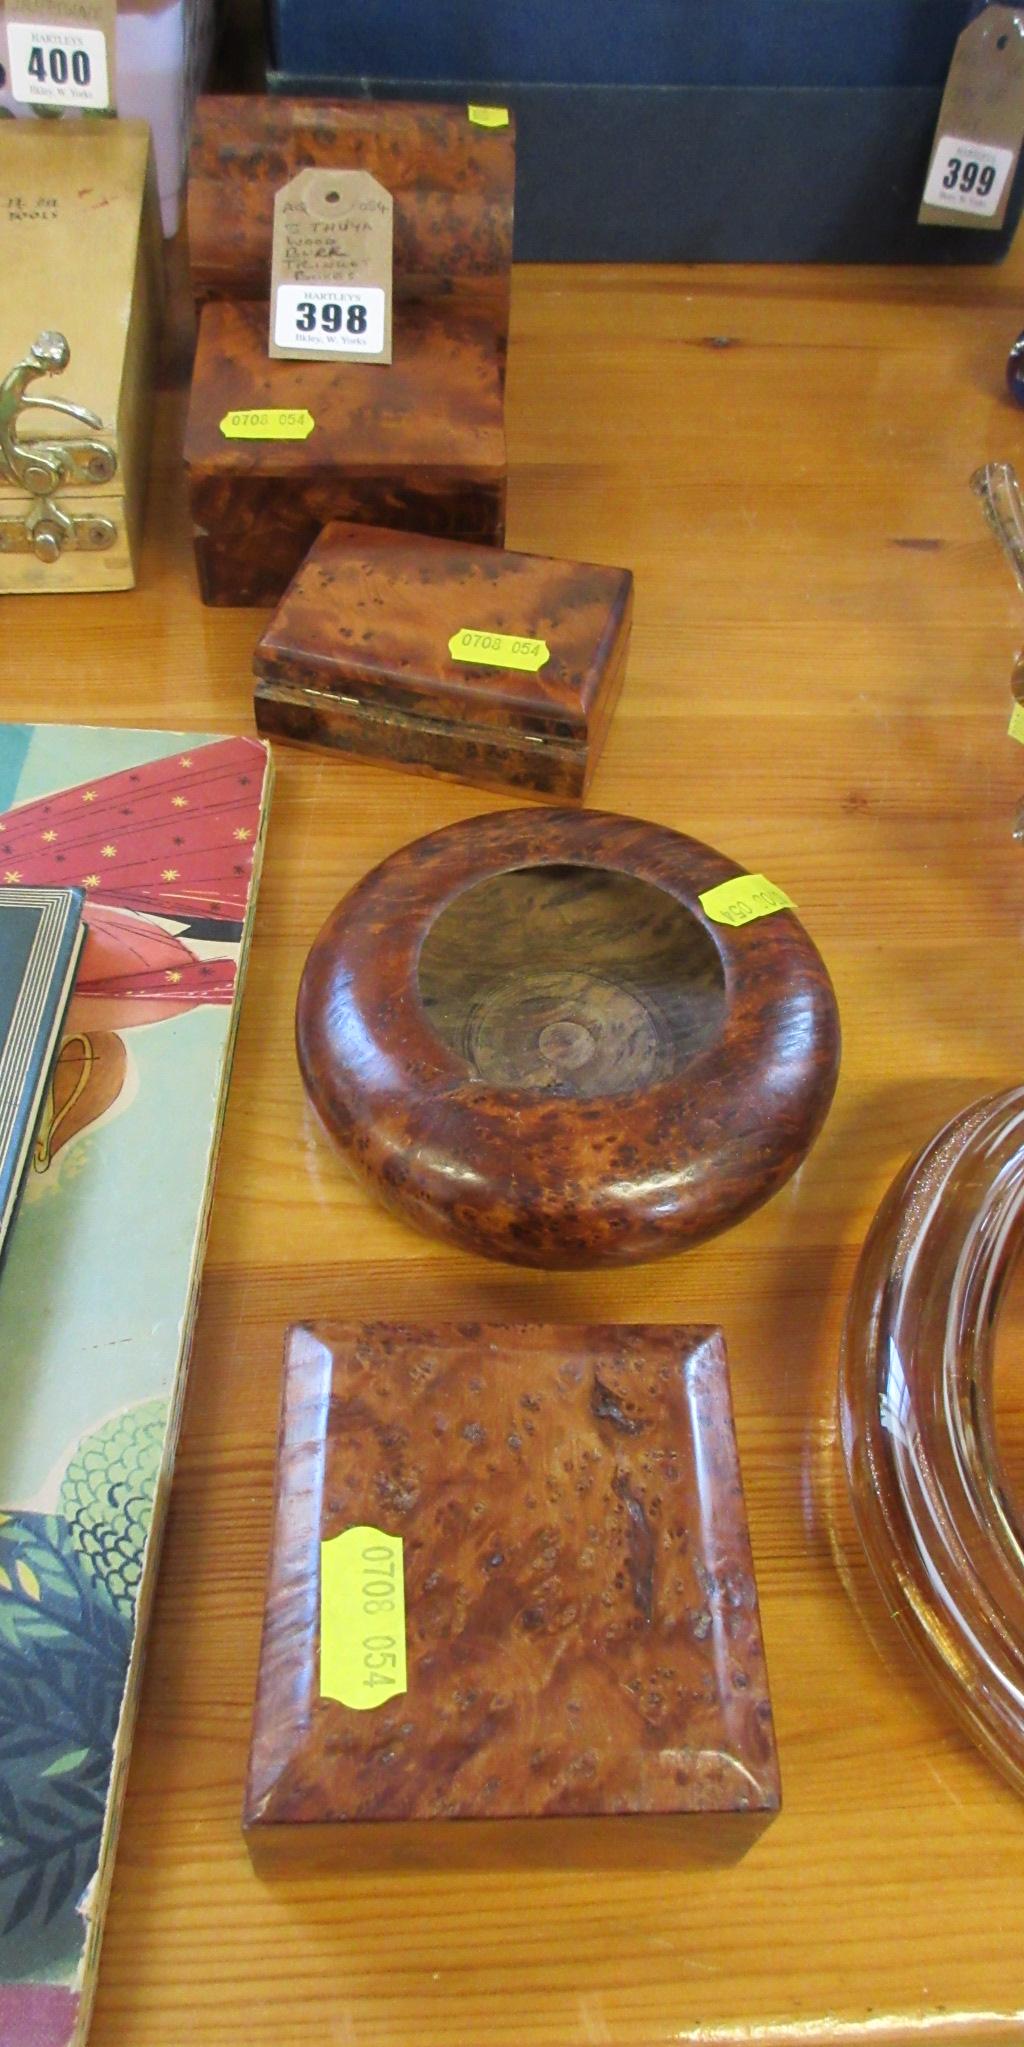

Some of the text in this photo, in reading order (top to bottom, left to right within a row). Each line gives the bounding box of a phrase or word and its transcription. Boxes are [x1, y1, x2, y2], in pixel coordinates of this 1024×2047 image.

[28, 47, 91, 86] 400
[942, 158, 997, 196] 399
[304, 292, 361, 301] HARTLEYS
[296, 302, 367, 334] 398
[279, 414, 305, 426] 054
[461, 633, 541, 656] 0708 054
[361, 1546, 397, 1688] 0708 054
